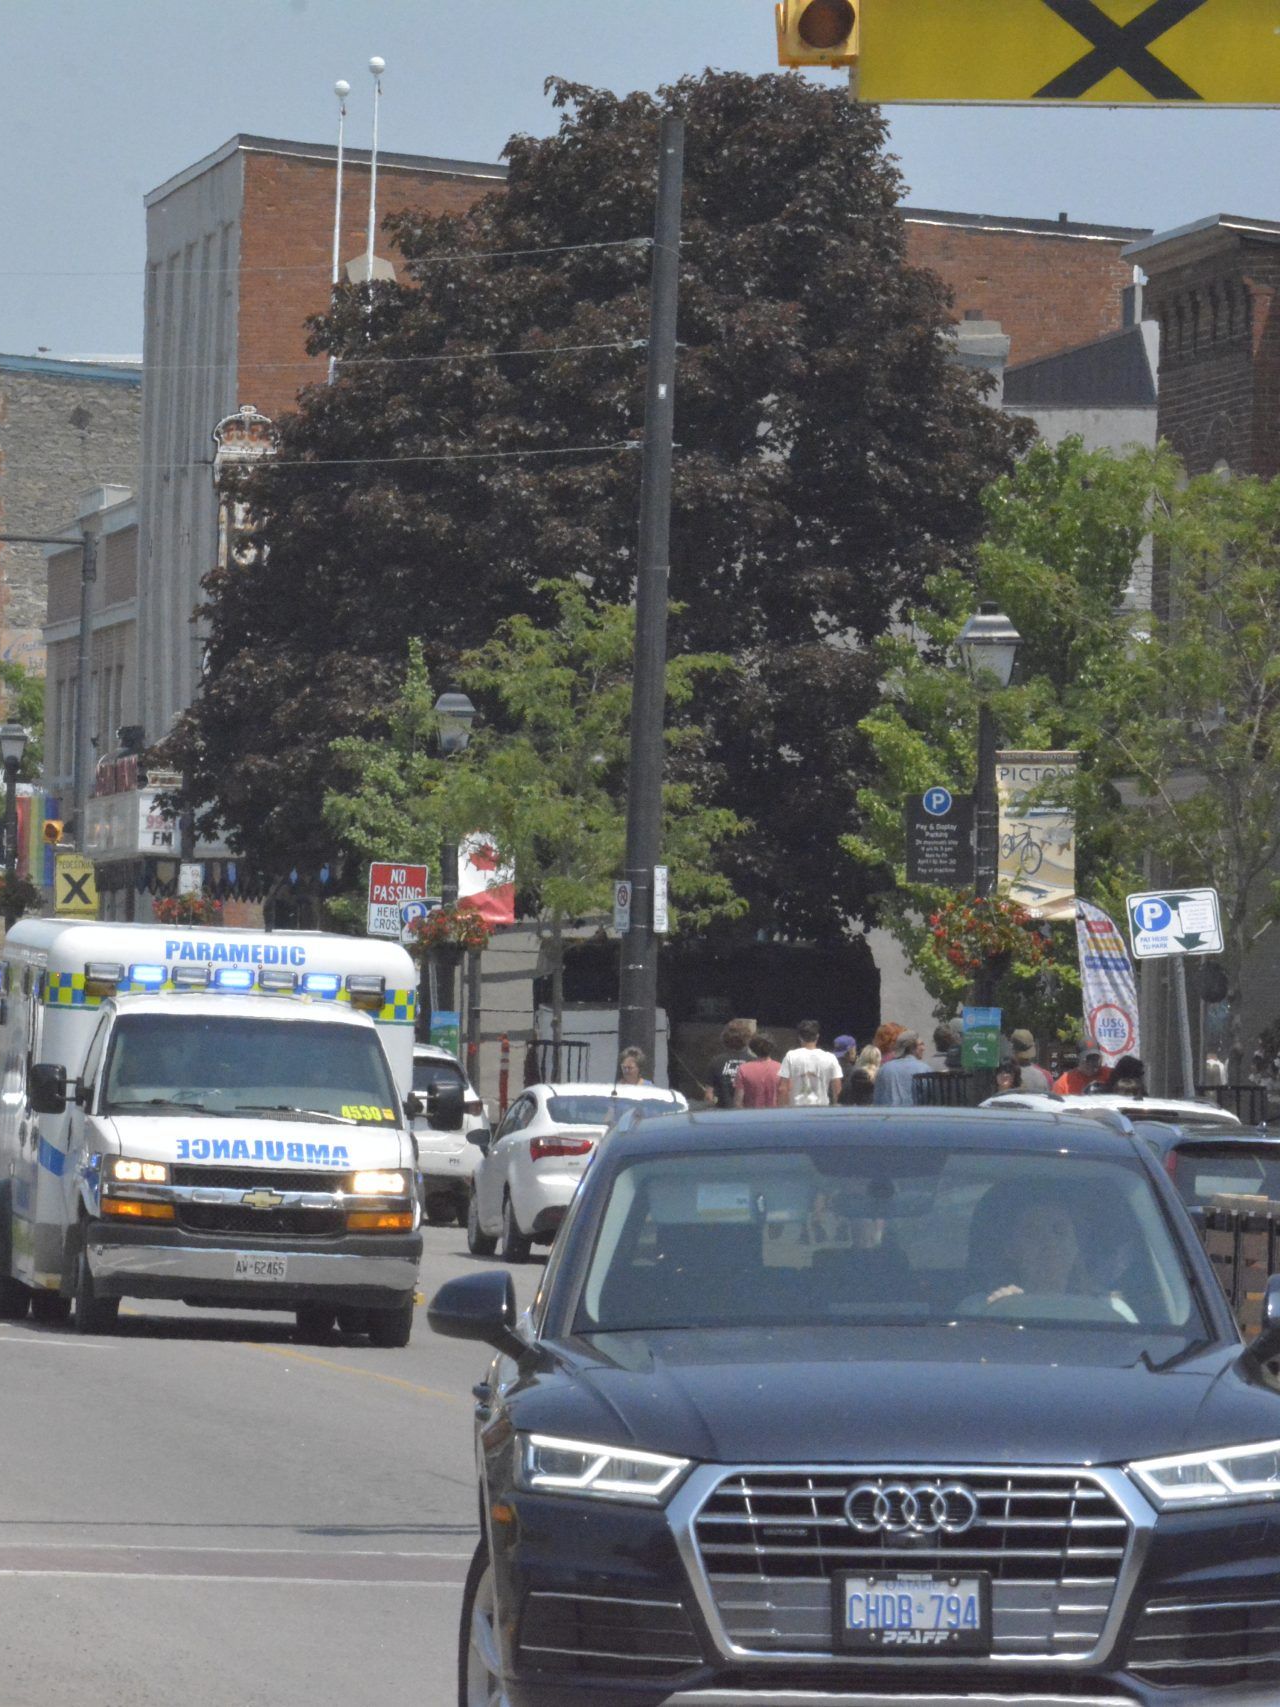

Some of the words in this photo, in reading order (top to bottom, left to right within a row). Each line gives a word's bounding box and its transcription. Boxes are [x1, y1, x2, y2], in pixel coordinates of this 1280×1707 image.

[932, 793, 945, 810] P
[152, 831, 173, 846] FM
[391, 869, 406, 885] NO
[62, 873, 92, 904] X
[373, 885, 422, 901] PASSING
[377, 906, 399, 918] HERE
[1142, 903, 1163, 929] P
[166, 940, 306, 966] PARAMEDIC
[341, 1105, 383, 1121] 4530
[848, 1594, 912, 1629] CHDB
[930, 1594, 978, 1629] 794
[882, 1631, 950, 1644] PFAFF
